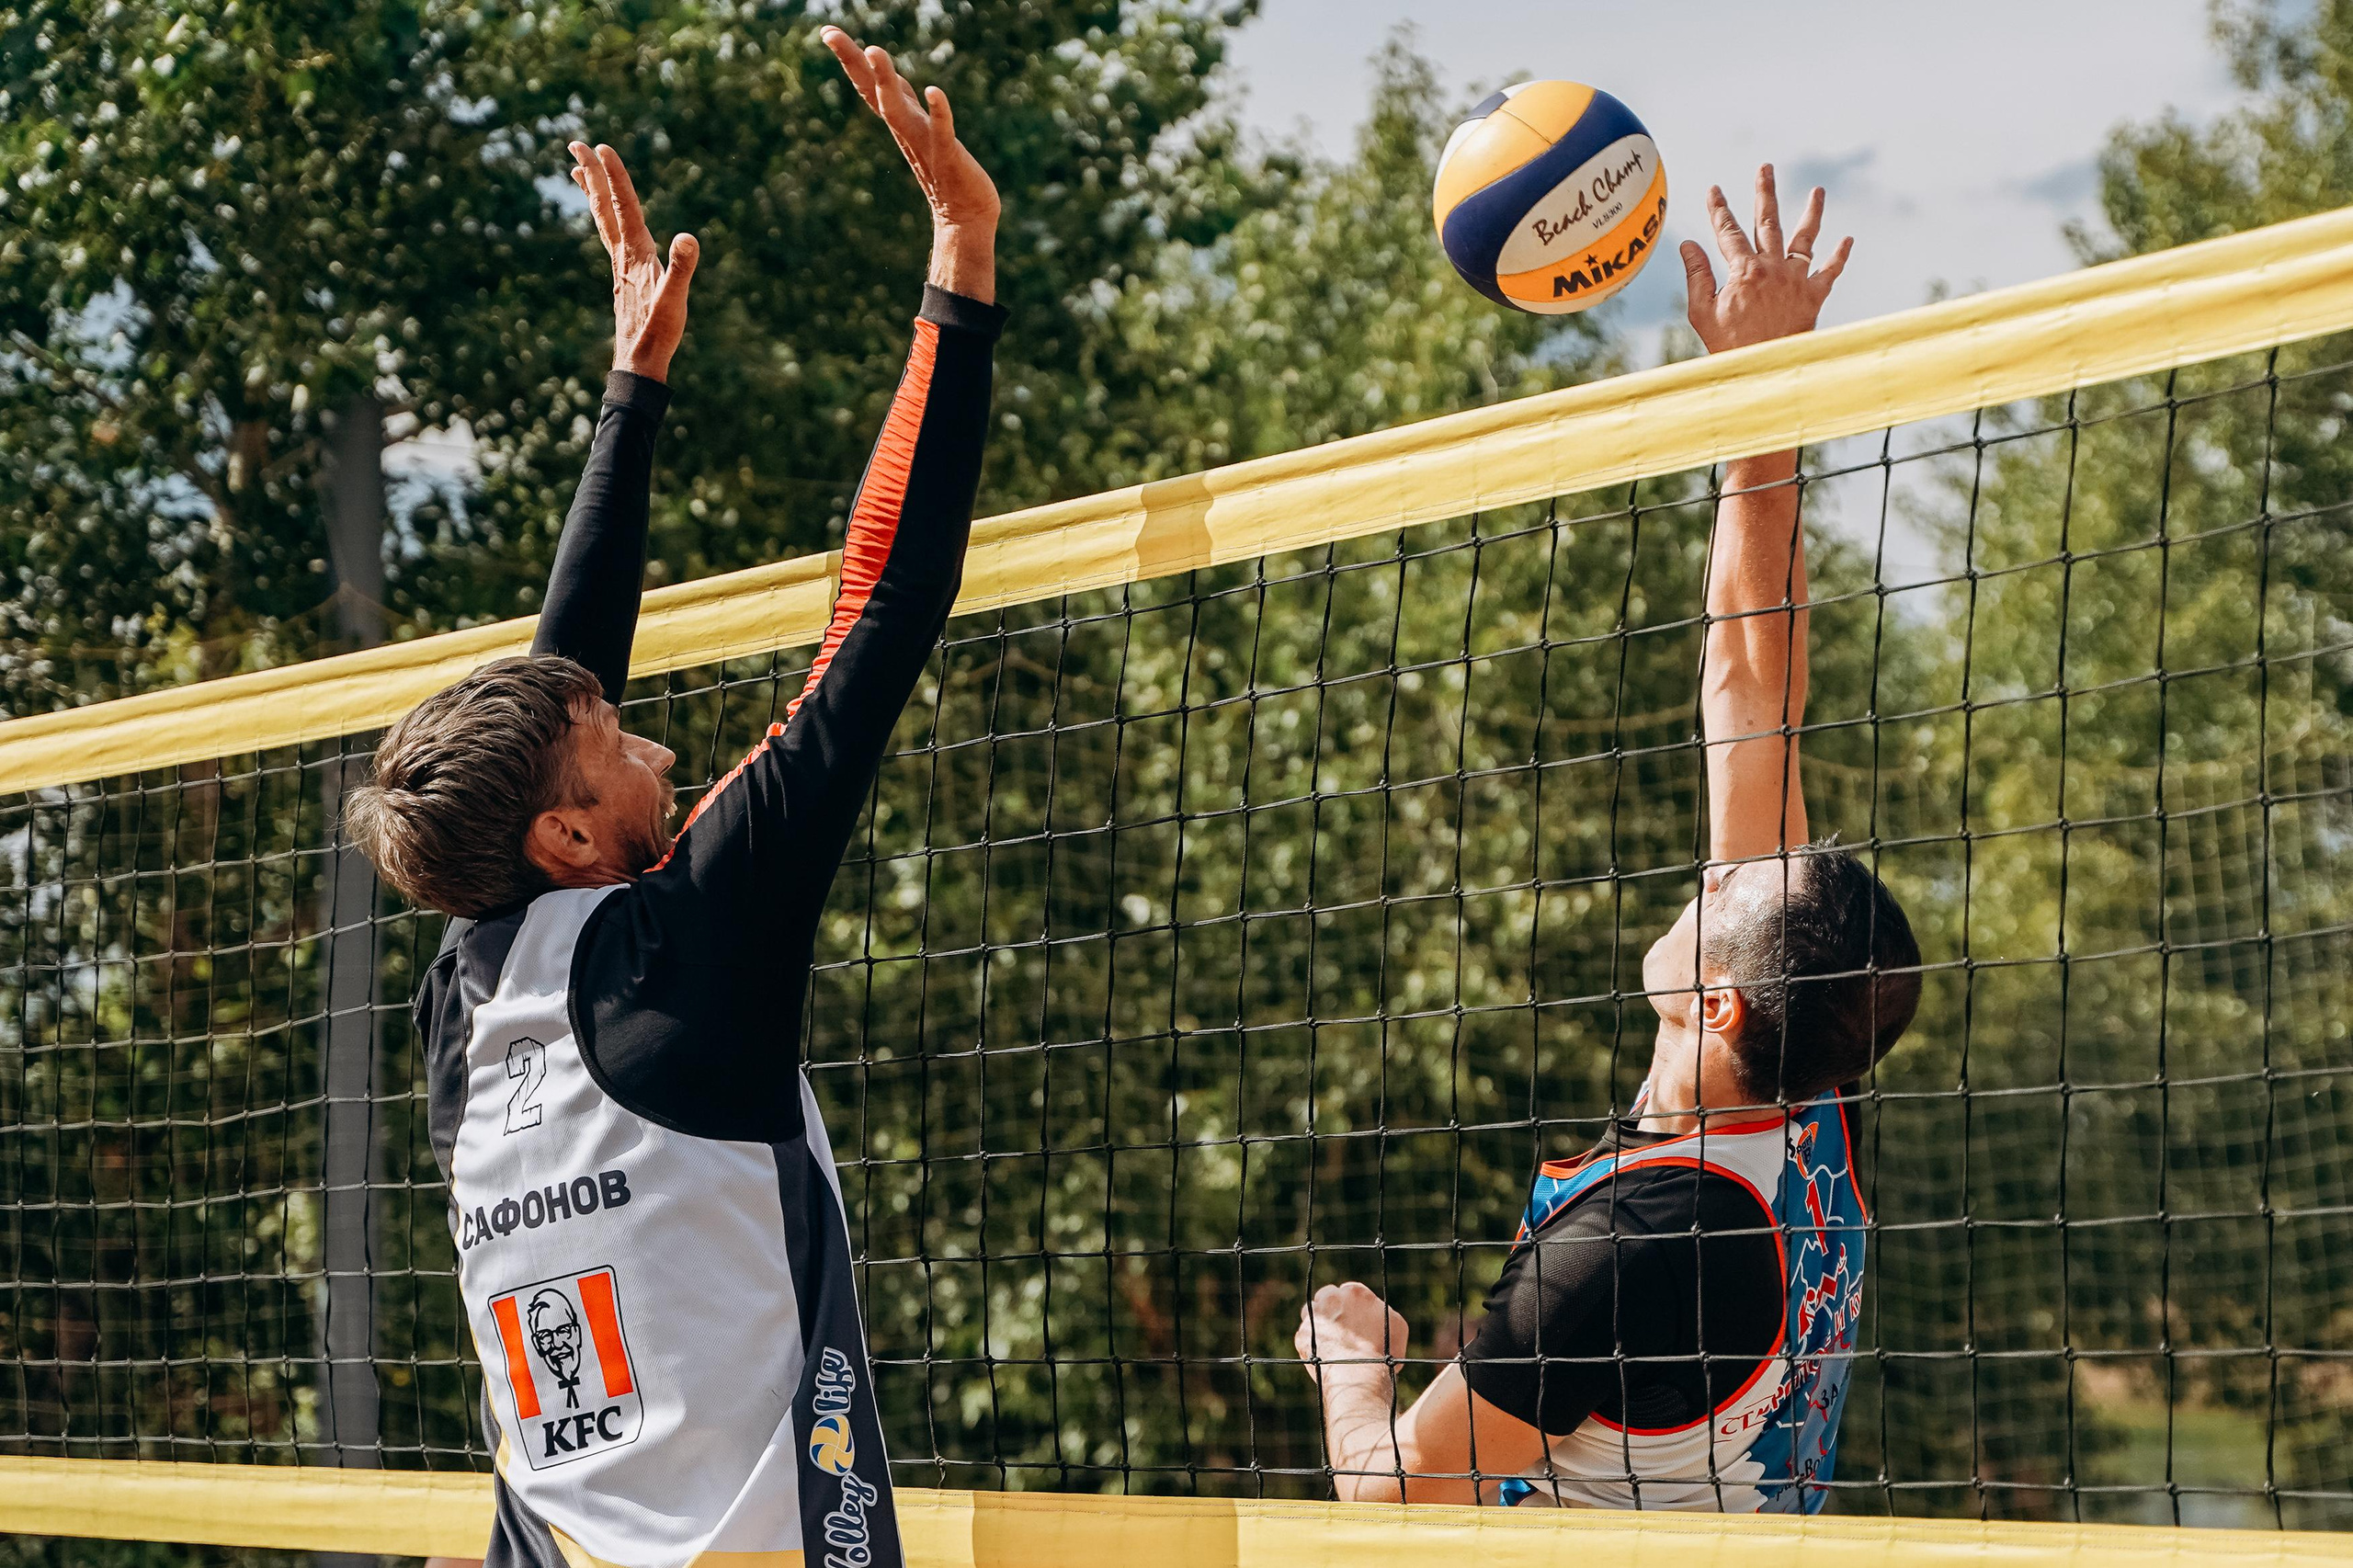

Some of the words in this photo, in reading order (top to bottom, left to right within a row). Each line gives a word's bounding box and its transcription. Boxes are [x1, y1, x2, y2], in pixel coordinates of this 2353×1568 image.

[1532, 190, 1594, 246] Beach
[1592, 149, 1643, 203] Champ
[504, 1036, 547, 1136] 2
[461, 1169, 631, 1251] САФОНОВ
[813, 1346, 857, 1415] life
[541, 1405, 623, 1458] KFC
